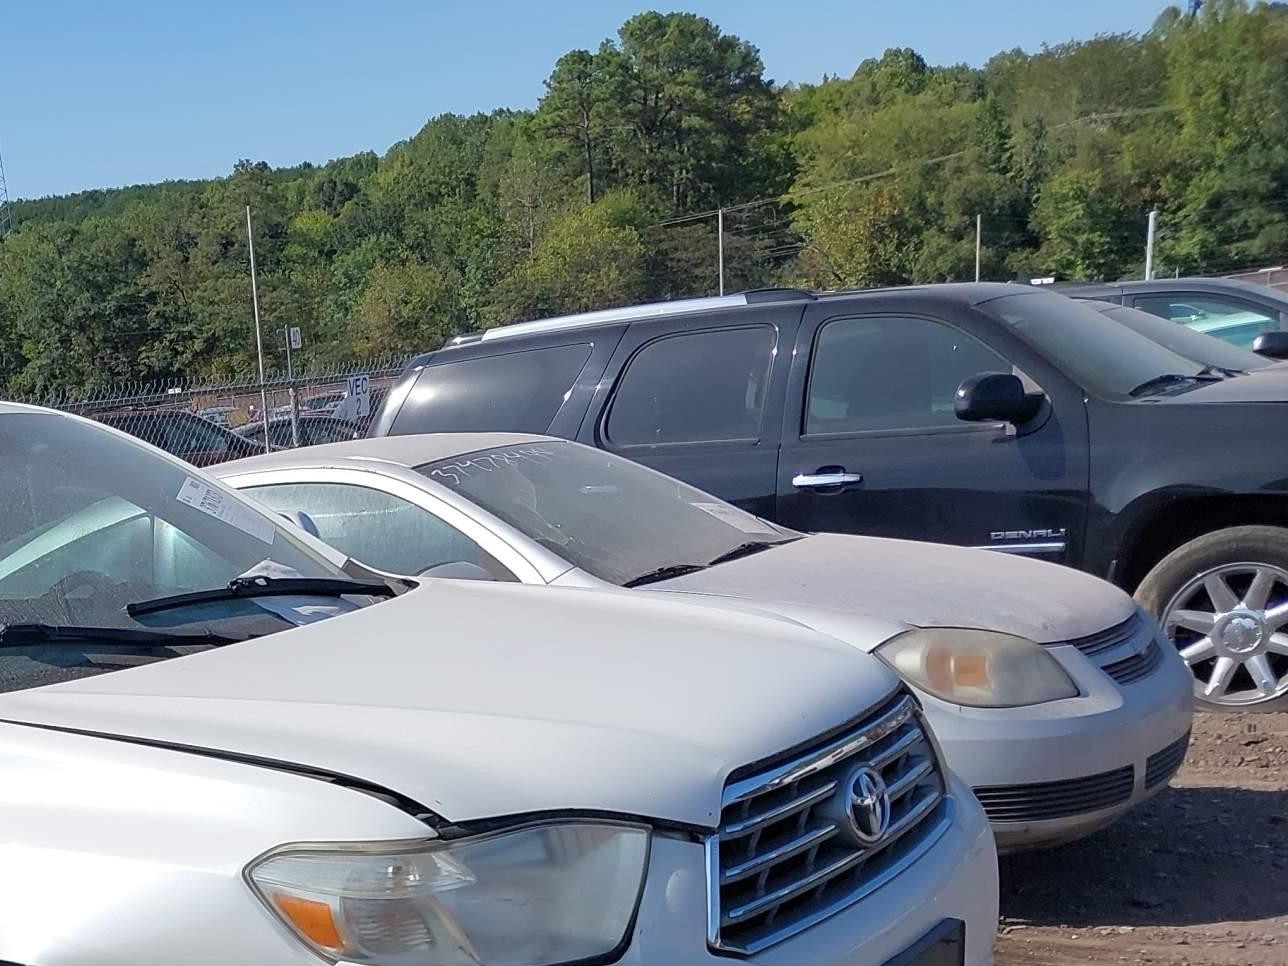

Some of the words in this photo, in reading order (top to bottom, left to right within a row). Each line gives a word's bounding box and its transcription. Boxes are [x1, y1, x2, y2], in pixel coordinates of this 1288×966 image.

[348, 377, 368, 396] VEC
[355, 398, 362, 415] 2
[989, 528, 1066, 540] DENALI
